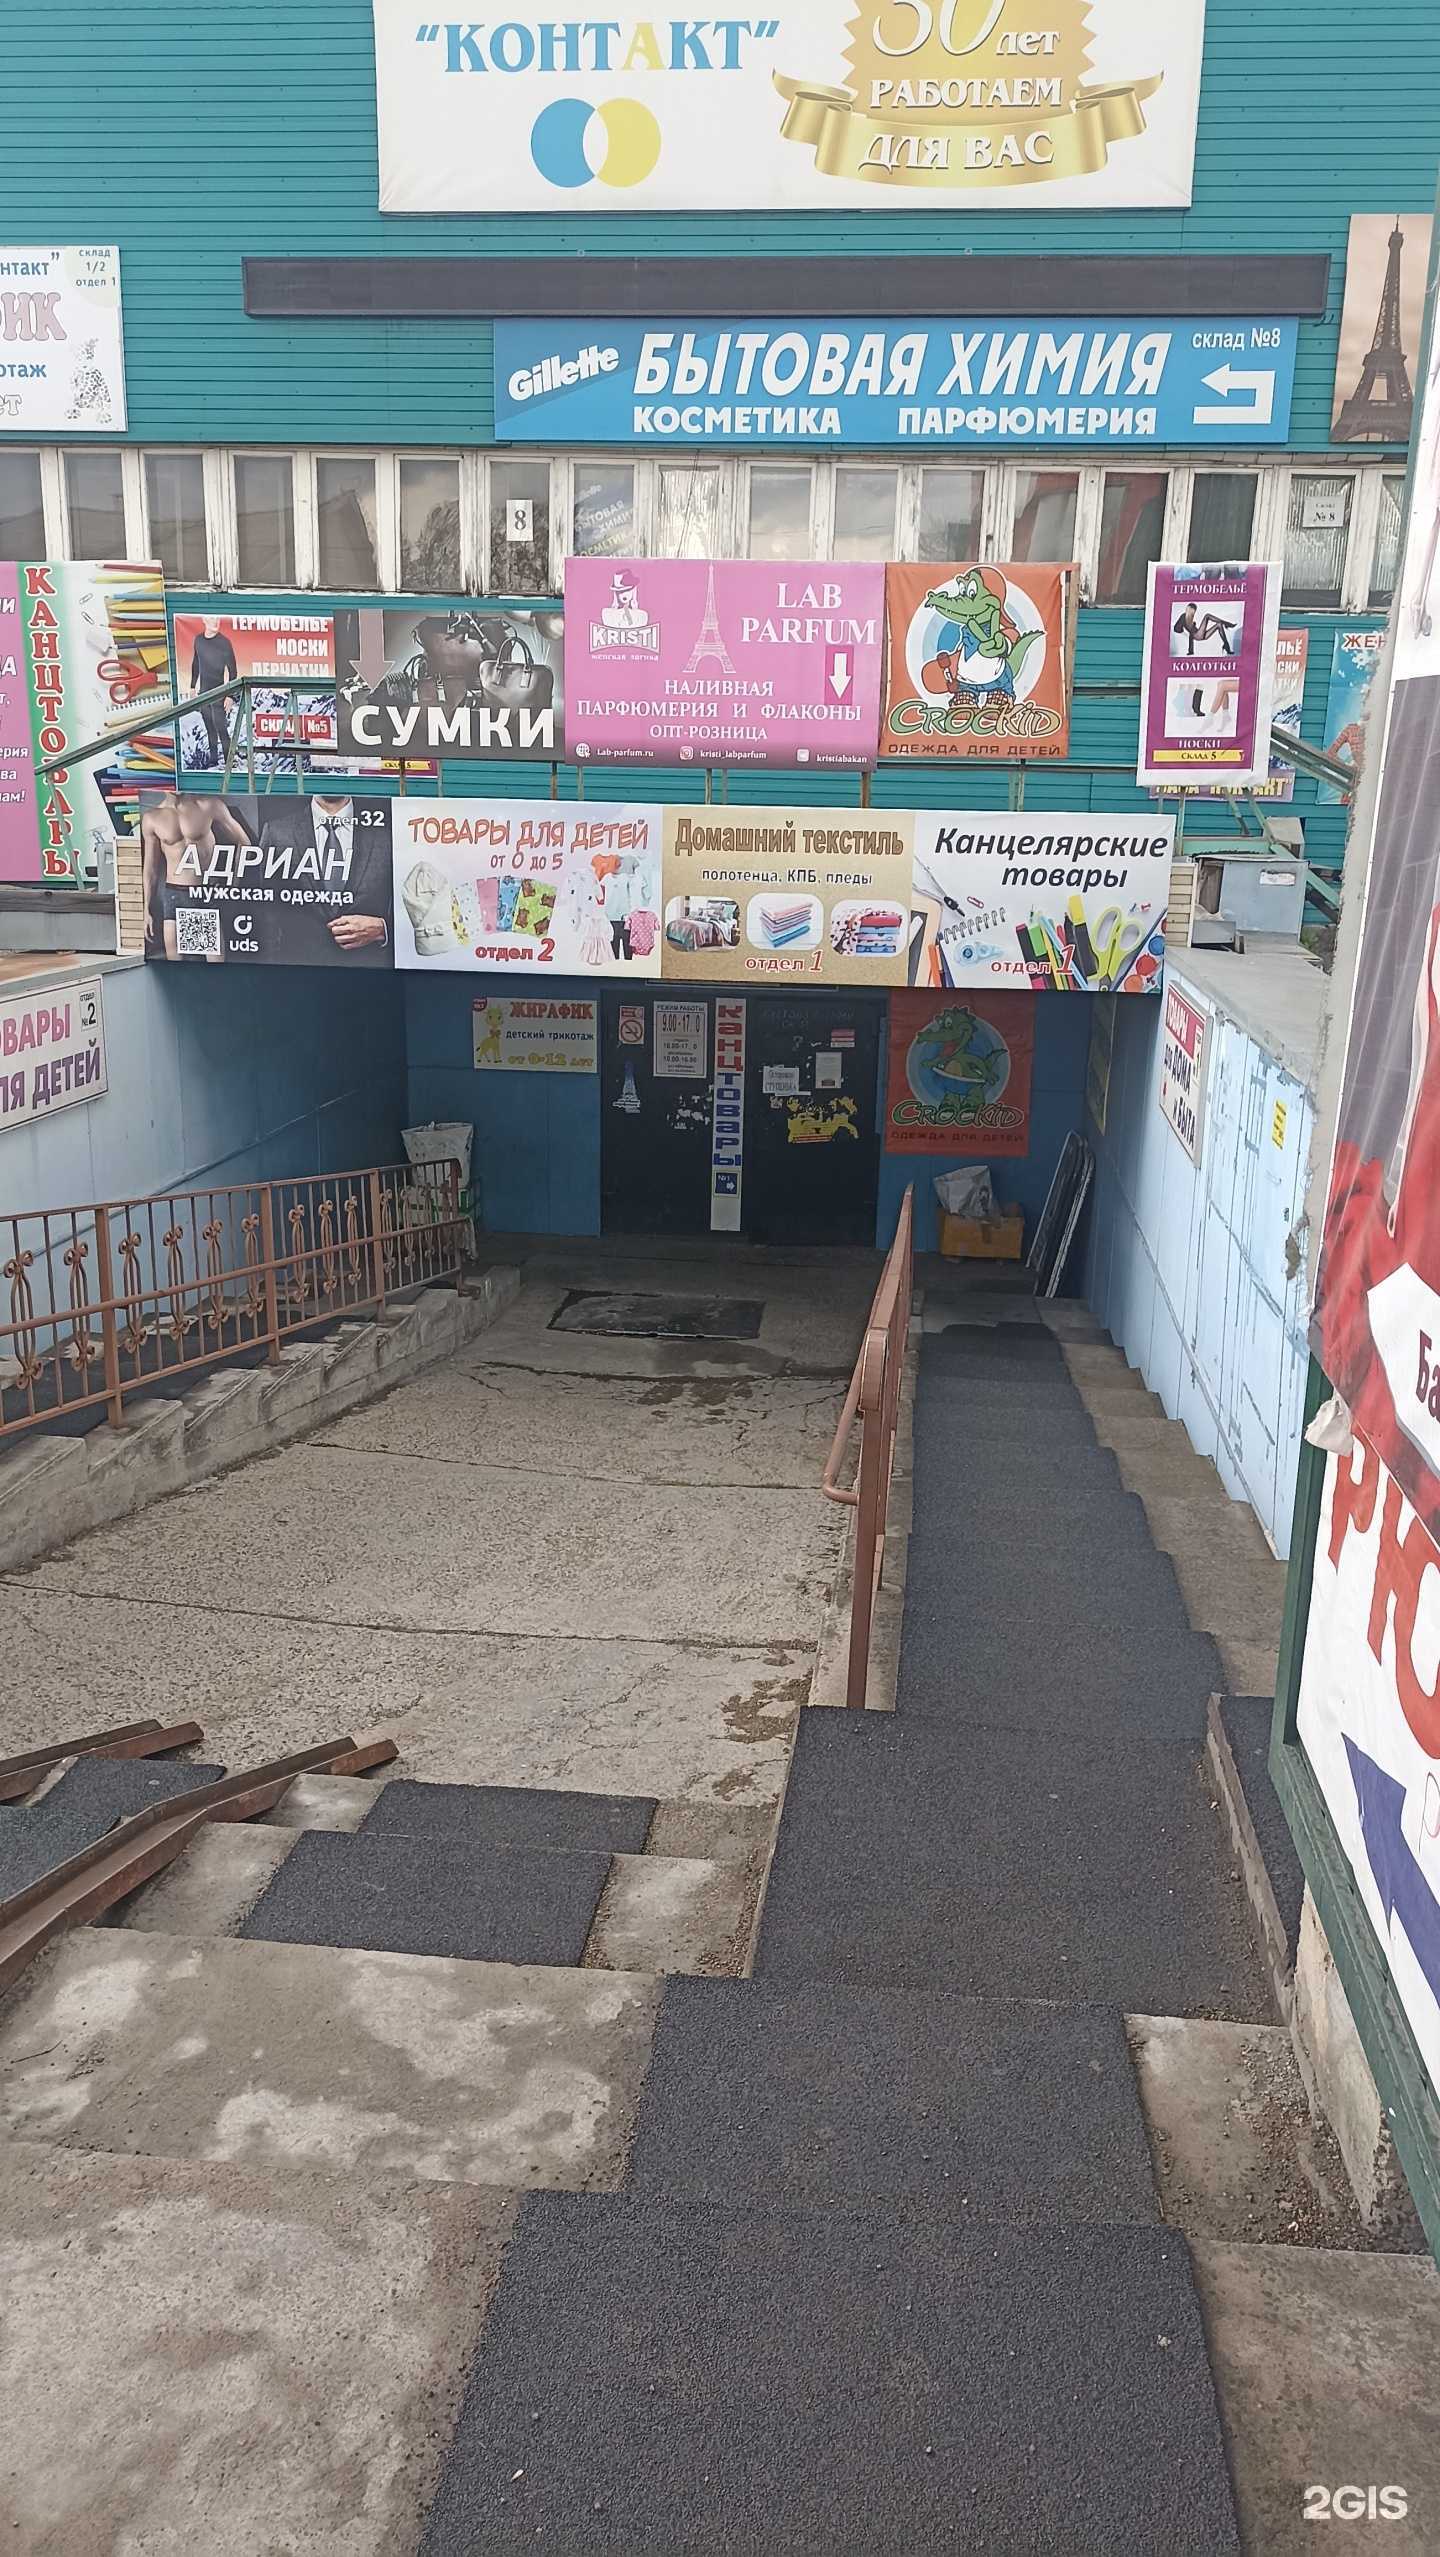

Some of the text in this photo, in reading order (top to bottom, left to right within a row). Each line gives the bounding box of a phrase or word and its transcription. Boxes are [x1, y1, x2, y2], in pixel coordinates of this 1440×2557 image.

[996, 31, 1060, 55] лет
[870, 78, 1062, 108] РАБОТАЕМ
[858, 131, 1055, 175] ДЛЯ ВАС
[79, 249, 110, 257] склад
[86, 262, 106, 272] 1/2
[76, 277, 116, 287] отдел 1
[0, 292, 67, 341] ИК
[1192, 327, 1281, 351] склад №8
[508, 345, 619, 401] Gillette
[633, 332, 1172, 396] БЫТОВАЯ ХИМИЯ
[633, 406, 841, 434] КОСМЕТИКА
[898, 407, 1157, 435] ПАРФЮМЕРИЯ
[514, 509, 526, 530] 8
[776, 582, 842, 609] LAB
[592, 626, 657, 649] KRISTI
[741, 617, 877, 645] PARFUM
[276, 638, 328, 657] НОСКИ
[1173, 661, 1236, 672] КОЛГОТКИ
[664, 679, 774, 697] НАЛИВНАЯ
[576, 700, 862, 721] ПАРФЮМЕРИЯ И ФЛАКОНЫ
[351, 705, 554, 748] СУМКИ
[650, 724, 768, 742] ОПТ-РОЗНИЦА
[888, 744, 1061, 756] ОДЕЖДА ДЛЯ ДЕТЕЙ
[1179, 739, 1221, 748] НОСКИ
[319, 810, 385, 827] отдел 32
[408, 816, 649, 853] ТОВАРЫ ДЛЯ ДЕТЕЙ
[675, 818, 904, 856] Домашний текстиль
[934, 827, 1168, 862] Канцелярские
[175, 844, 353, 886] АДРИАН
[552, 852, 563, 870] 5
[826, 871, 872, 885] пледы
[1002, 866, 1128, 893] товары
[189, 886, 353, 906] мужская одежда
[229, 938, 259, 952] uds
[475, 938, 555, 962] отдел 2
[745, 950, 824, 972] отдел 1
[991, 944, 1075, 975] отдел 1
[510, 1001, 594, 1020] ЖИРАФИК
[0, 1003, 70, 1056] ВАРЫ
[505, 1029, 594, 1041] детский трикотаж
[32, 1037, 100, 1110] ДЕТЕЙ
[1171, 1045, 1192, 1096] ДОМА
[1177, 1097, 1196, 1149] БЫТА
[890, 1131, 946, 1142] ОДЕЖДА
